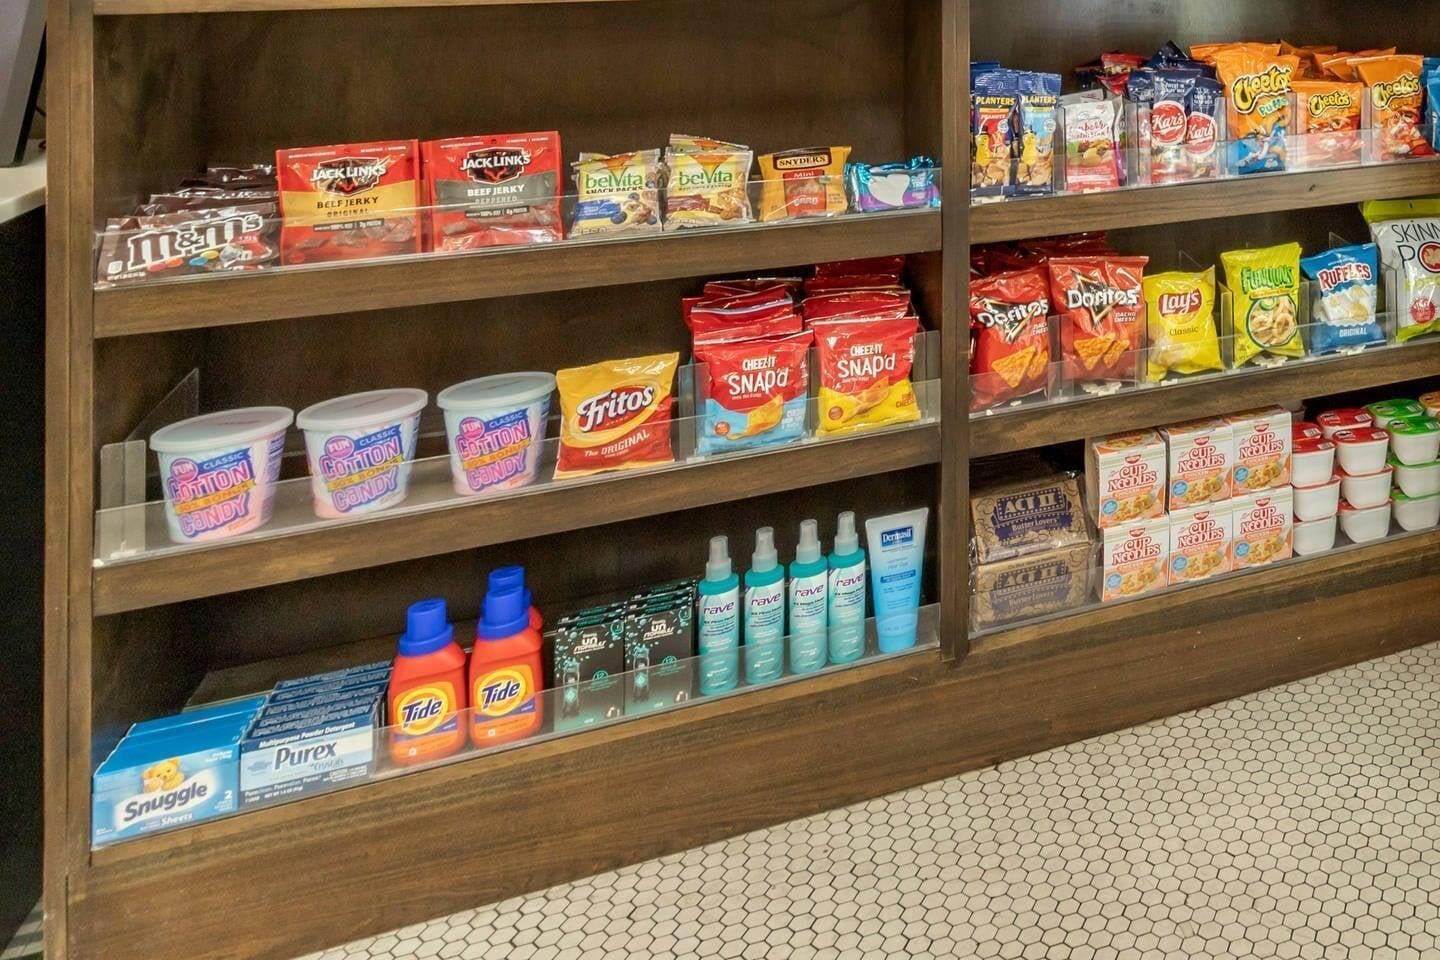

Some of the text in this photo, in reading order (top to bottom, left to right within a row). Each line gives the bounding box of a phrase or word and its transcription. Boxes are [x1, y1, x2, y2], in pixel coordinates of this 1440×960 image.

[1233, 65, 1291, 111] Cheetos
[1374, 74, 1420, 108] Cheetos
[976, 96, 1015, 106] PLANTERS
[1309, 92, 1351, 117] Cheetos
[1152, 113, 1184, 132] Kar's
[460, 156, 492, 170] JACK
[312, 168, 346, 182] JACK
[467, 184, 525, 197] BEEF JERKY
[317, 196, 378, 209] BEEF JERKY
[1319, 264, 1371, 288] RUFFLES
[1067, 289, 1138, 309] Doritos
[1162, 290, 1199, 314] Lay's
[978, 299, 1048, 328] Doritos
[1169, 325, 1198, 336] Classic
[1339, 327, 1368, 337] ORIGINAL
[577, 384, 655, 433] Fritos
[488, 411, 524, 429] CLASSIC
[358, 428, 397, 447] CLASSIC
[456, 419, 529, 459] COTTON
[584, 430, 649, 458] The ORIGINAL
[1250, 432, 1275, 446] CUP
[320, 436, 400, 476] COTTON
[1189, 445, 1216, 460] CUP
[1239, 439, 1283, 459] NOODLES
[203, 451, 243, 470] CLASSIC
[1178, 453, 1226, 473] NOODLES
[1119, 463, 1146, 479] CUP
[170, 463, 251, 502] COTTON
[1108, 471, 1157, 491] NOODLES
[1003, 496, 1037, 516] ACT
[1251, 506, 1277, 521] CUP
[1189, 519, 1216, 535] CUP
[1240, 514, 1285, 534] NOODLES
[1123, 536, 1151, 552] CUP
[1177, 527, 1226, 549] NOODLES
[1112, 543, 1160, 565] NOODLES
[836, 572, 864, 587] rave
[751, 592, 781, 606] rave
[795, 584, 824, 598] rave
[703, 601, 735, 616] rave
[481, 677, 521, 709] Tide
[402, 696, 443, 728] Tide
[274, 740, 337, 770] Purex
[123, 782, 207, 822] Snuggle
[224, 790, 233, 799] 2
[161, 813, 193, 826] Sheets
